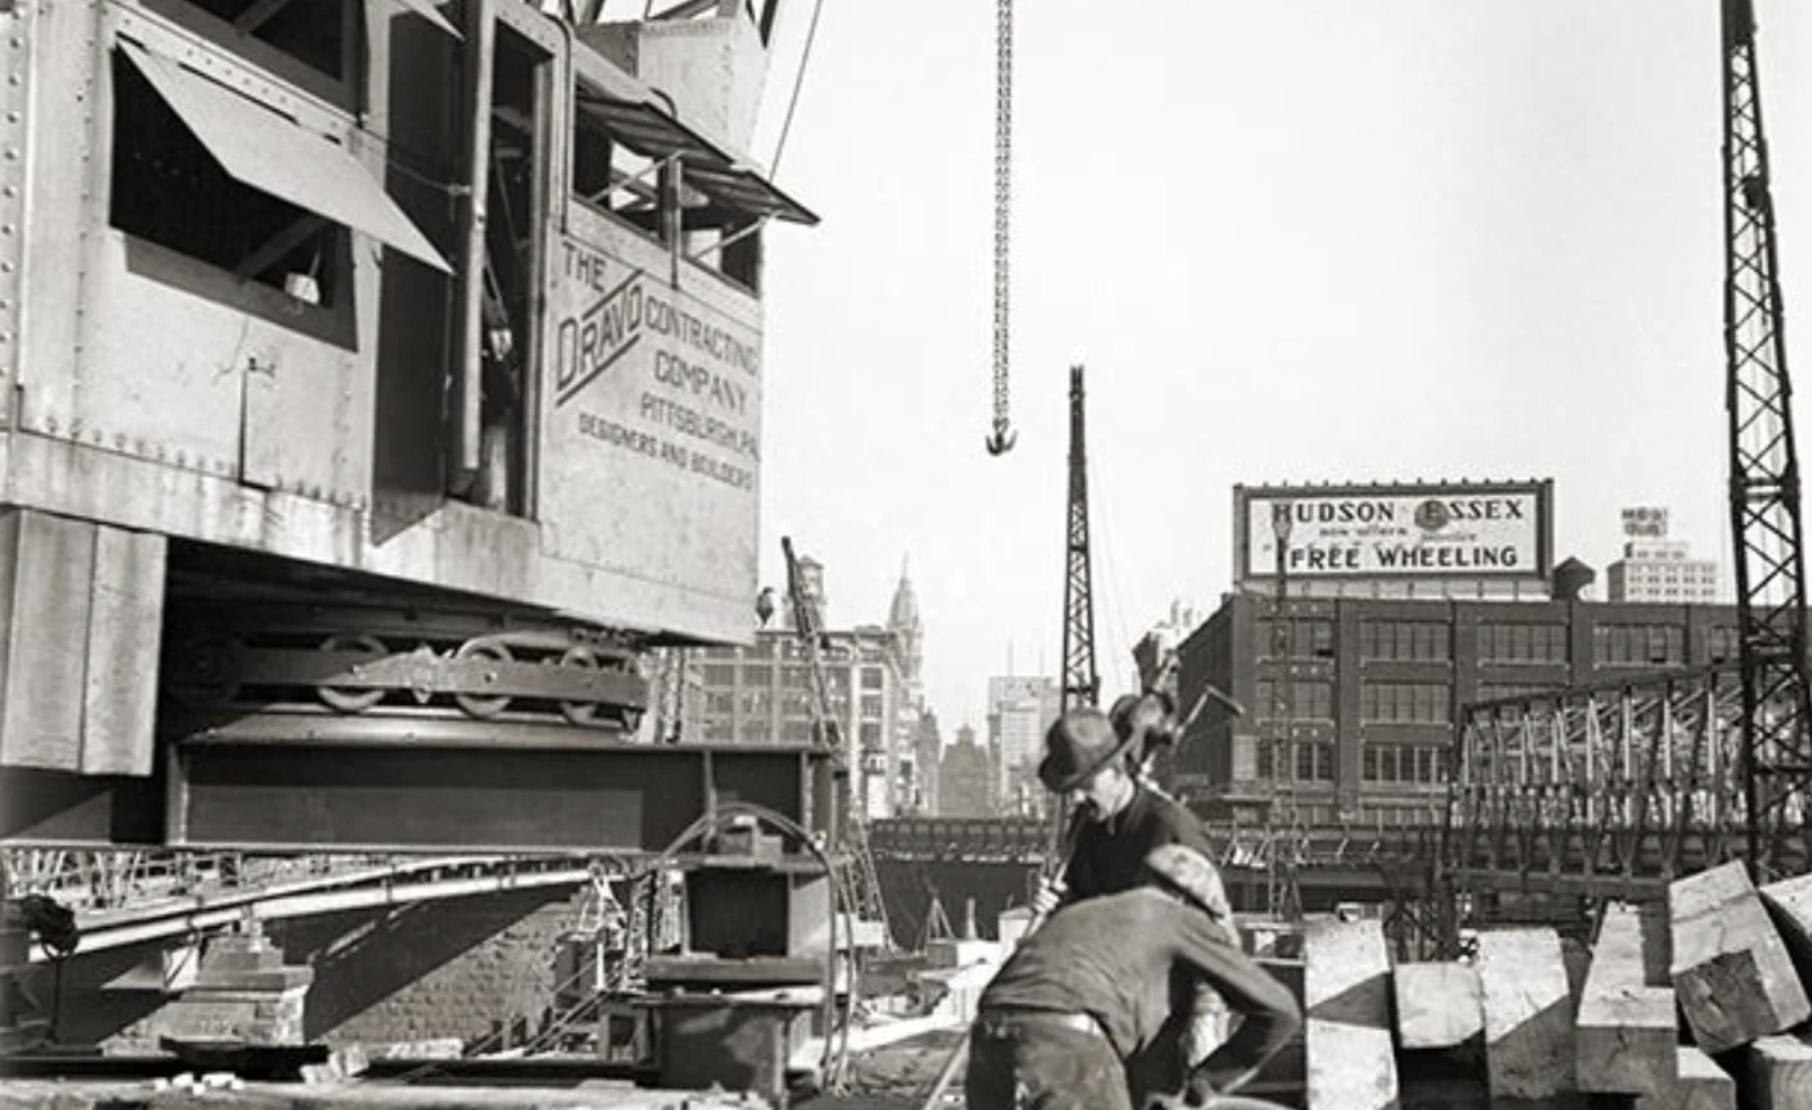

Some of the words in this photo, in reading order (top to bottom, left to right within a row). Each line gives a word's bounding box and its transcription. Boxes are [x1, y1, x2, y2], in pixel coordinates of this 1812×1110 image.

[563, 240, 606, 293] THE
[557, 284, 643, 392] DRAVO
[645, 296, 759, 377] CONTRACTING
[655, 349, 747, 416] COMPANY
[579, 411, 657, 458] DESIGNERS
[661, 441, 688, 470] AND
[692, 452, 754, 493] BUILDERS
[1273, 502, 1395, 522] HUDSON
[1425, 499, 1523, 520] ESSEX
[1290, 547, 1360, 570] FREE
[1375, 546, 1518, 567] WHEELING
